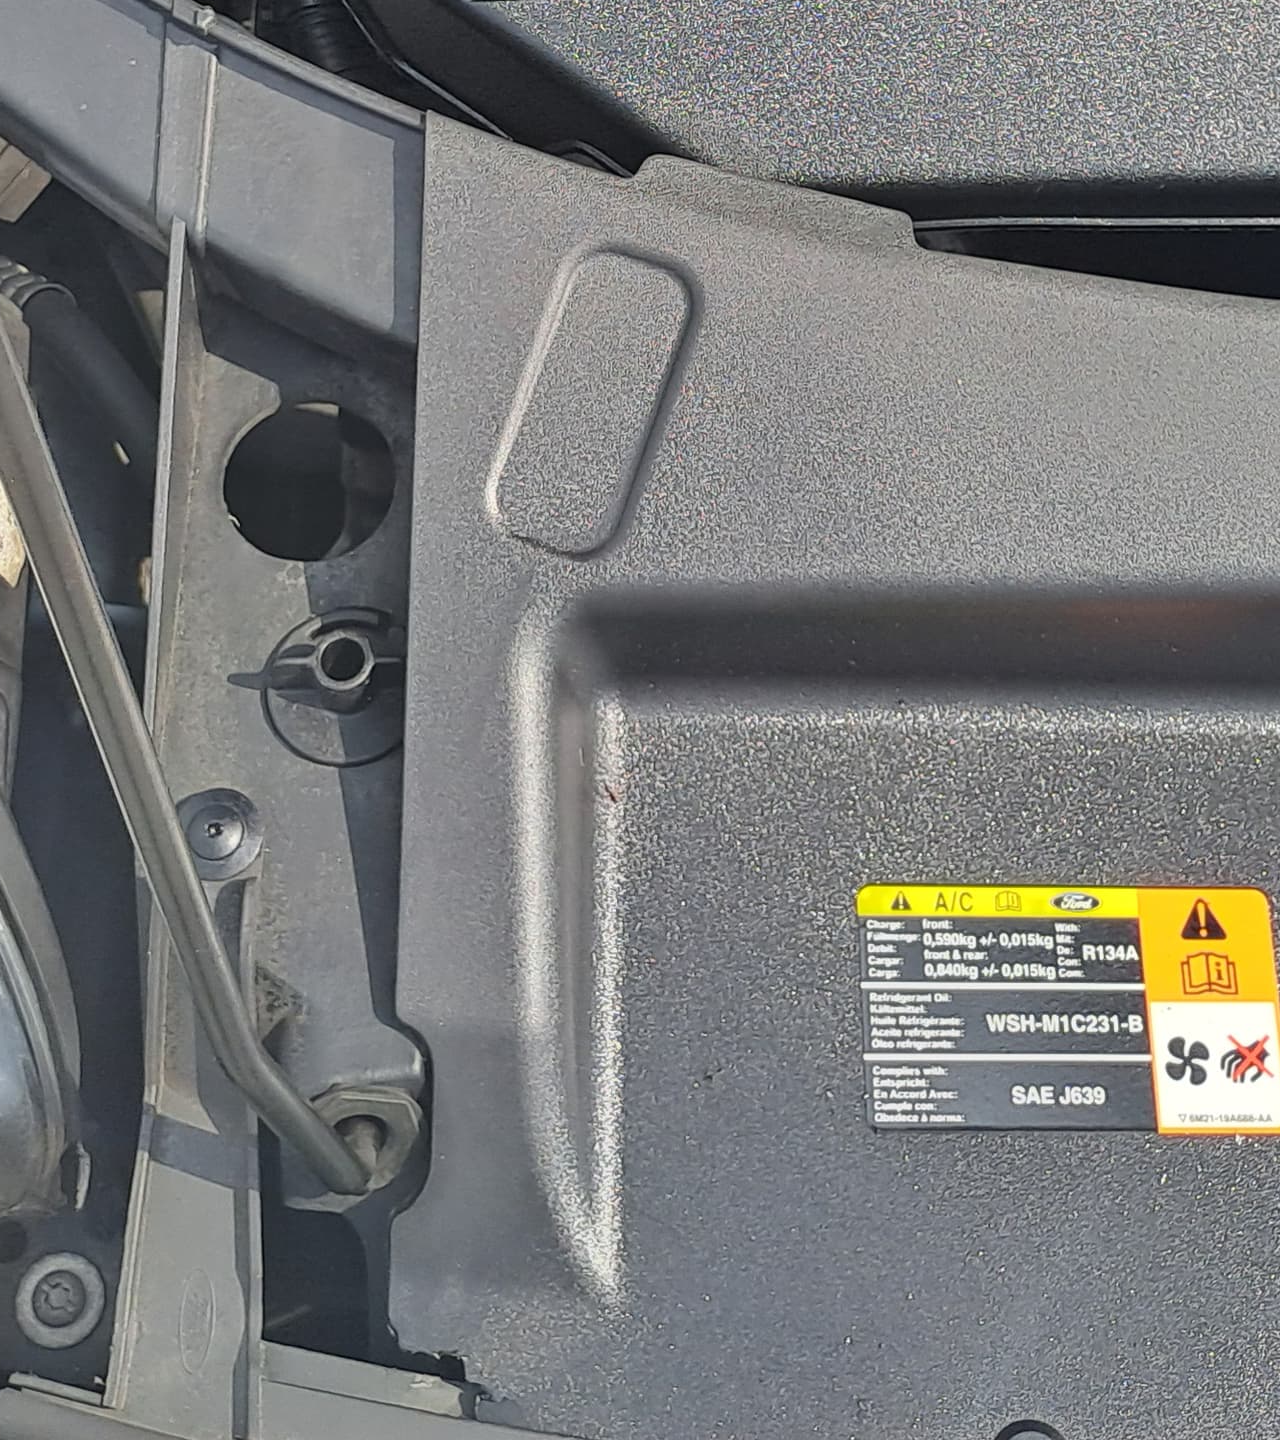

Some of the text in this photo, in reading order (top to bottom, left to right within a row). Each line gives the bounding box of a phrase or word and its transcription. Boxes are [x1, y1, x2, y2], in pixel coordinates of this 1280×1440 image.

[934, 892, 1097, 912] A/C Ford
[866, 919, 906, 931] Charge:
[922, 918, 953, 930] front:
[922, 931, 1054, 951] 0,590kg +/- 0,015kg
[923, 949, 950, 960] front
[952, 949, 962, 960] &
[1082, 943, 1139, 961] R134A
[924, 962, 1056, 981] 0,840kg +/- 0,015kg
[933, 992, 952, 1002] Oil:
[985, 1014, 1144, 1034] WSH-M1C231-B
[873, 1089, 959, 1099] En Accord Avec:
[1011, 1086, 1106, 1105] SAE J639
